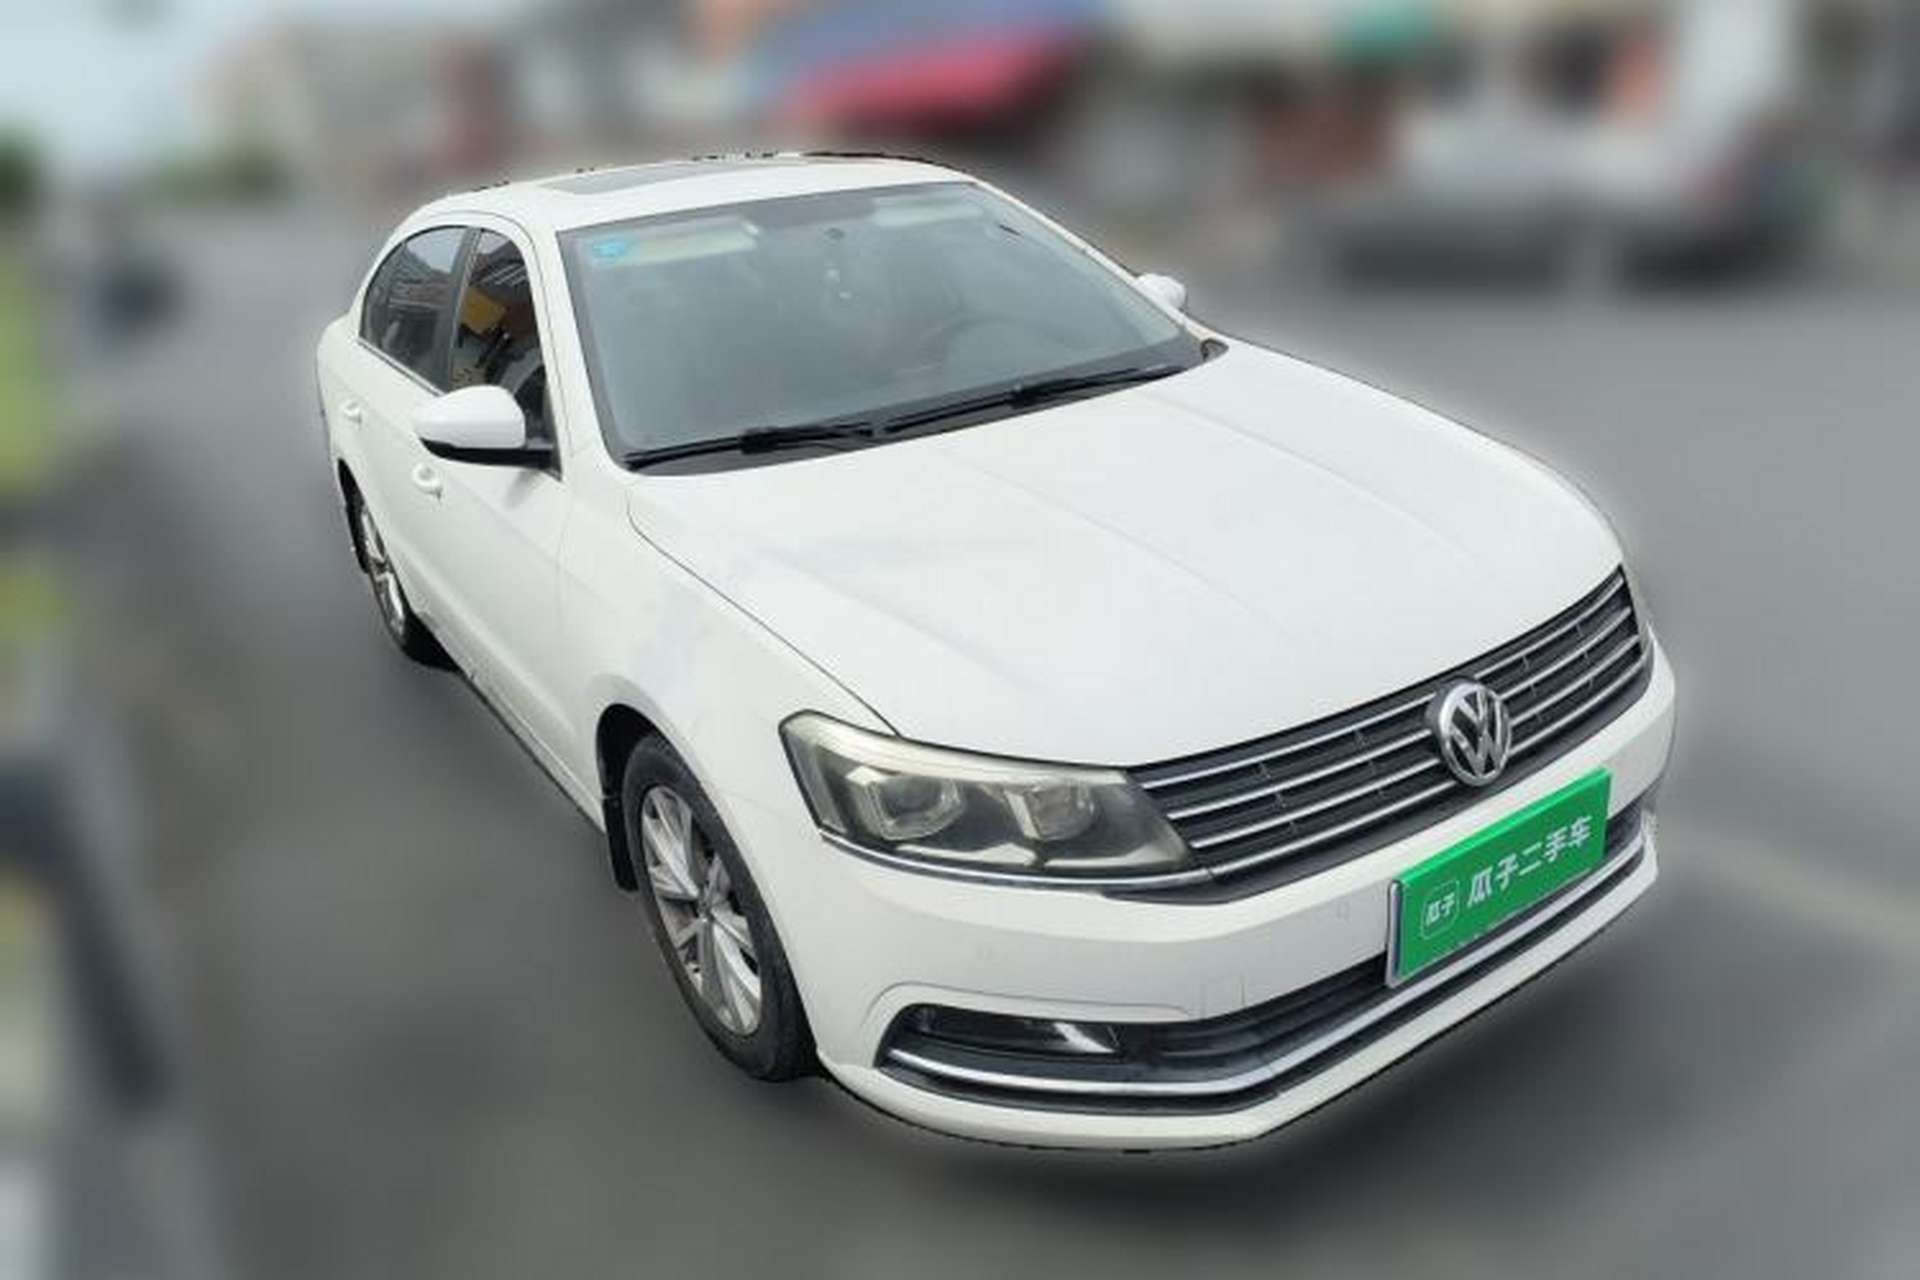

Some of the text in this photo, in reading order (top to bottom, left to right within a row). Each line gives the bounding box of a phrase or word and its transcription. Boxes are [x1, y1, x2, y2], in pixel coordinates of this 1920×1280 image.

[1467, 814, 1593, 908] 瓜子二手车
[1425, 893, 1455, 926] 瓜子
